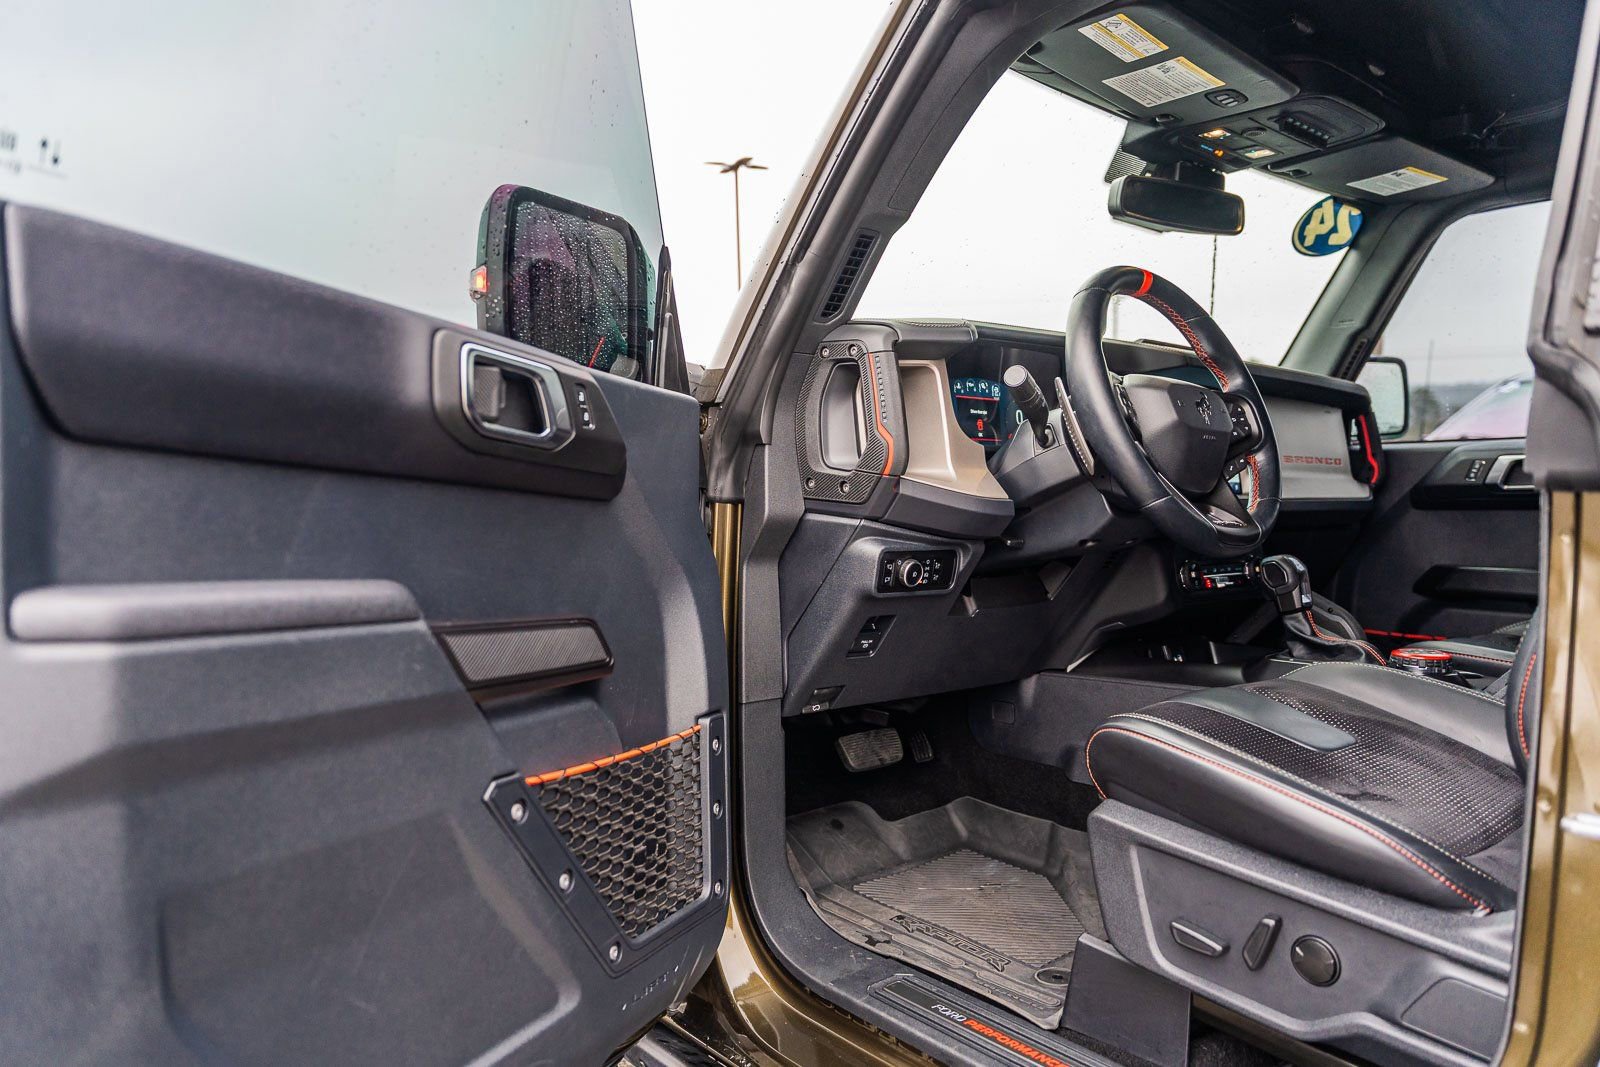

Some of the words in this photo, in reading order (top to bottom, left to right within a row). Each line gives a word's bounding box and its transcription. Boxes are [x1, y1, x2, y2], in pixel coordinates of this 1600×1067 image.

[1282, 455, 1342, 465] BRONCO
[889, 915, 1011, 972] RAPTOR
[931, 1004, 967, 1022] FORD
